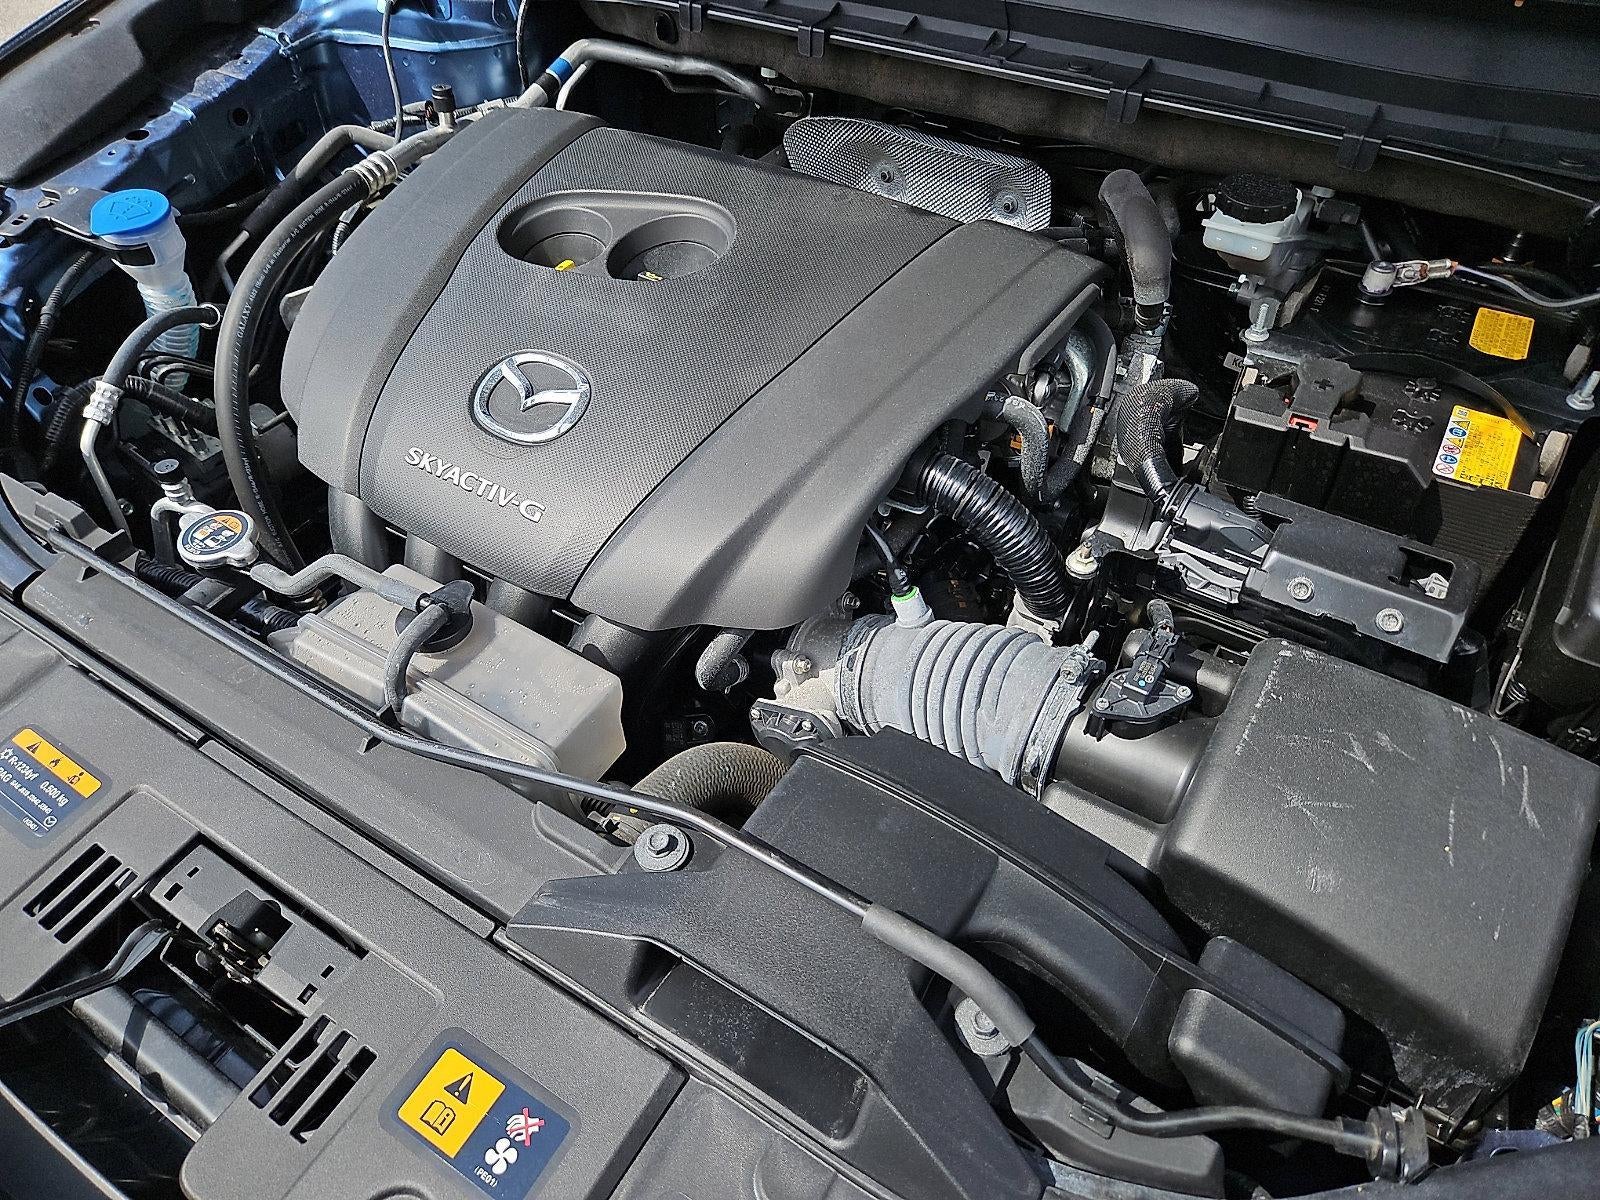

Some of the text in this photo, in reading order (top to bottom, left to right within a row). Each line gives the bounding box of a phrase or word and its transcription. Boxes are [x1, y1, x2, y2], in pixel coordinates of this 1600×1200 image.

[237, 302, 252, 338] GALAXY
[404, 447, 546, 523] SKYACTIV-G
[8, 756, 70, 807] R-1234yf 0.500 kg
[474, 1165, 499, 1188] (PE01)
